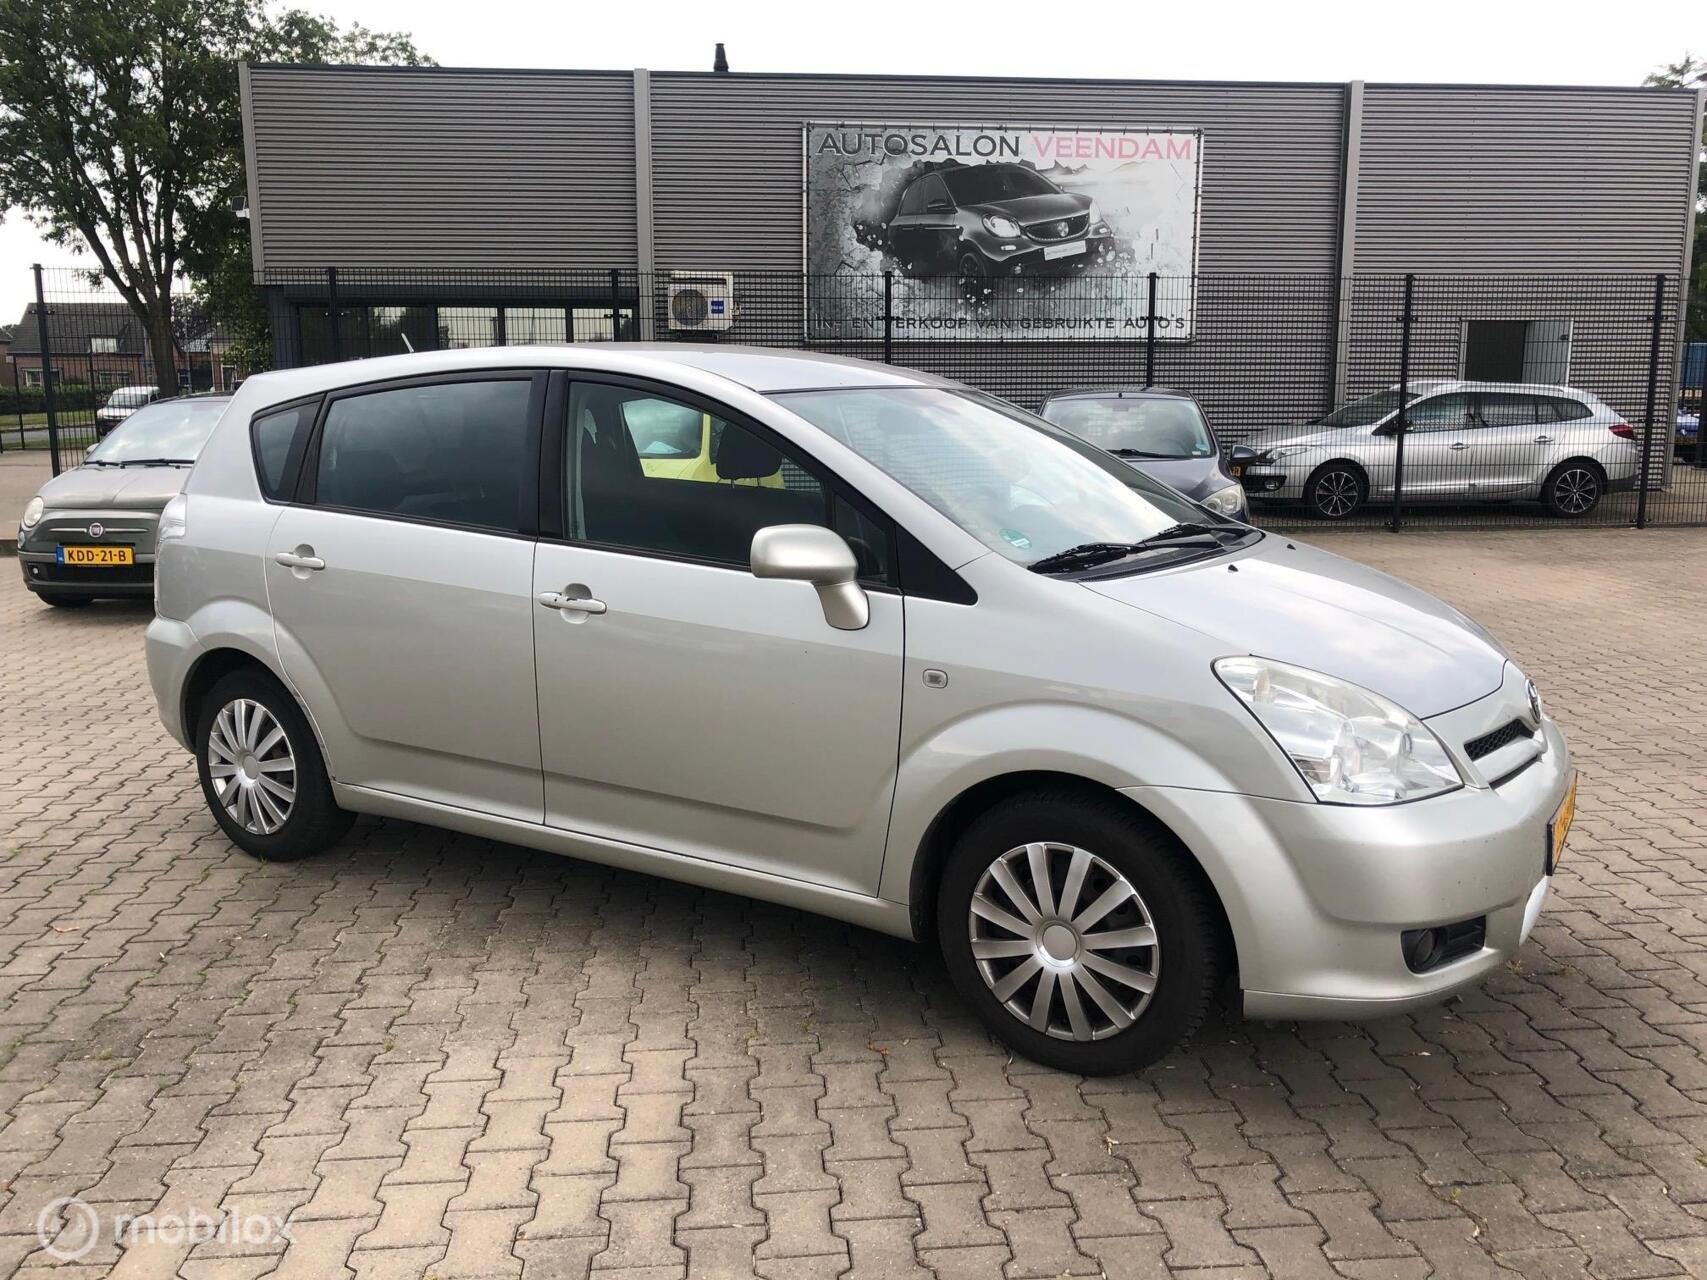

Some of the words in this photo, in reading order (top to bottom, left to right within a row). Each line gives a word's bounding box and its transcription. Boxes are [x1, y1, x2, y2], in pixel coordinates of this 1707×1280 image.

[816, 133, 1020, 157] AUTOSALON
[1033, 136, 1191, 160] VEENDAM
[852, 317, 874, 329] EN
[880, 316, 968, 329] ERKOOP
[976, 317, 1012, 329] VAN
[1020, 317, 1115, 329] GEBRUIKTE
[67, 550, 127, 562] KDD-21-B
